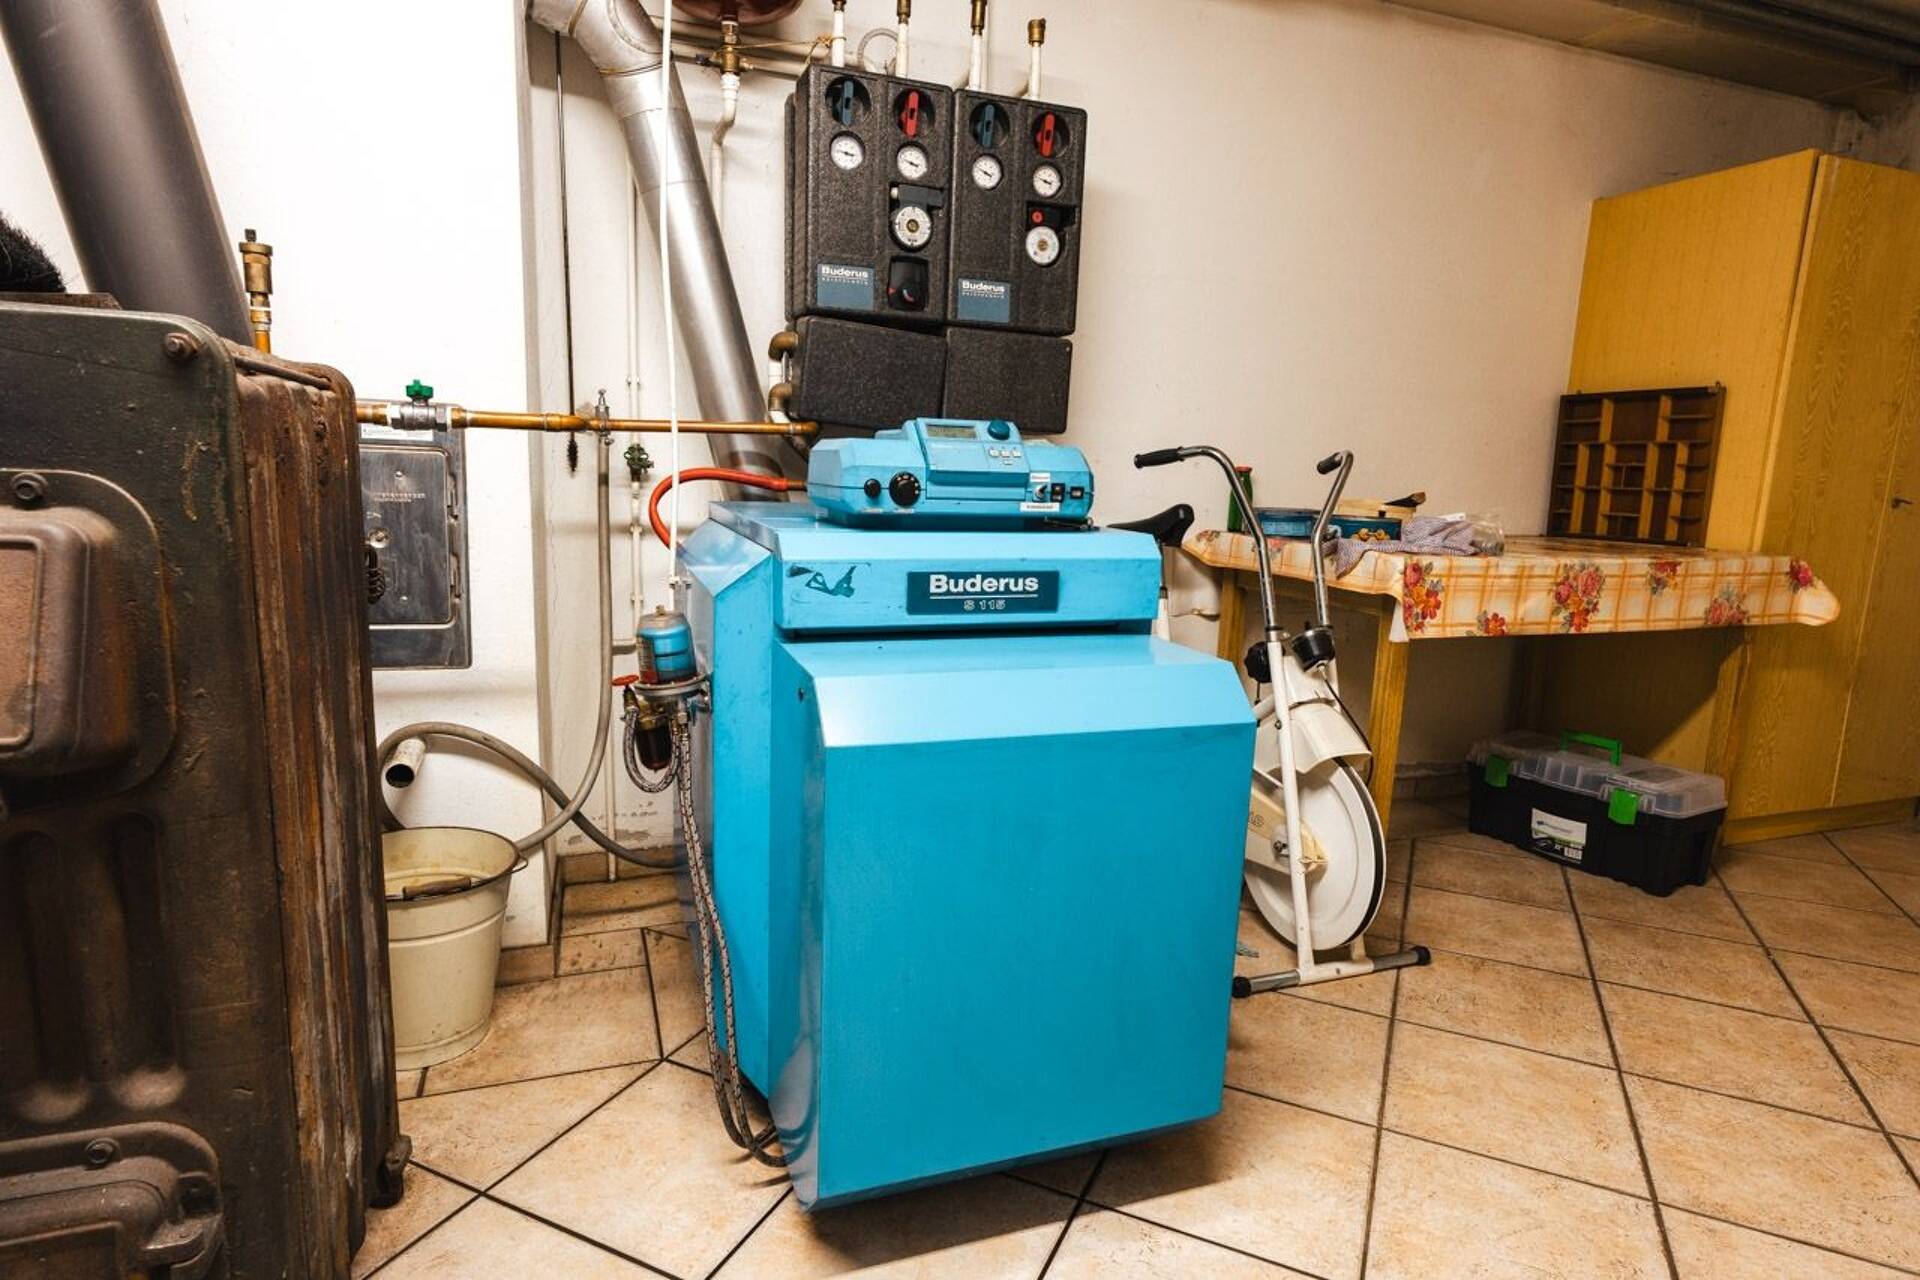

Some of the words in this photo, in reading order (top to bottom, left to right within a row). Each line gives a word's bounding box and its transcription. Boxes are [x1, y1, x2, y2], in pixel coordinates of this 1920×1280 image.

[821, 266, 869, 278] Buderus
[962, 280, 1005, 292] Buderus
[929, 573, 1039, 593] Buderus
[963, 600, 975, 611] S
[979, 599, 1006, 610] 115
